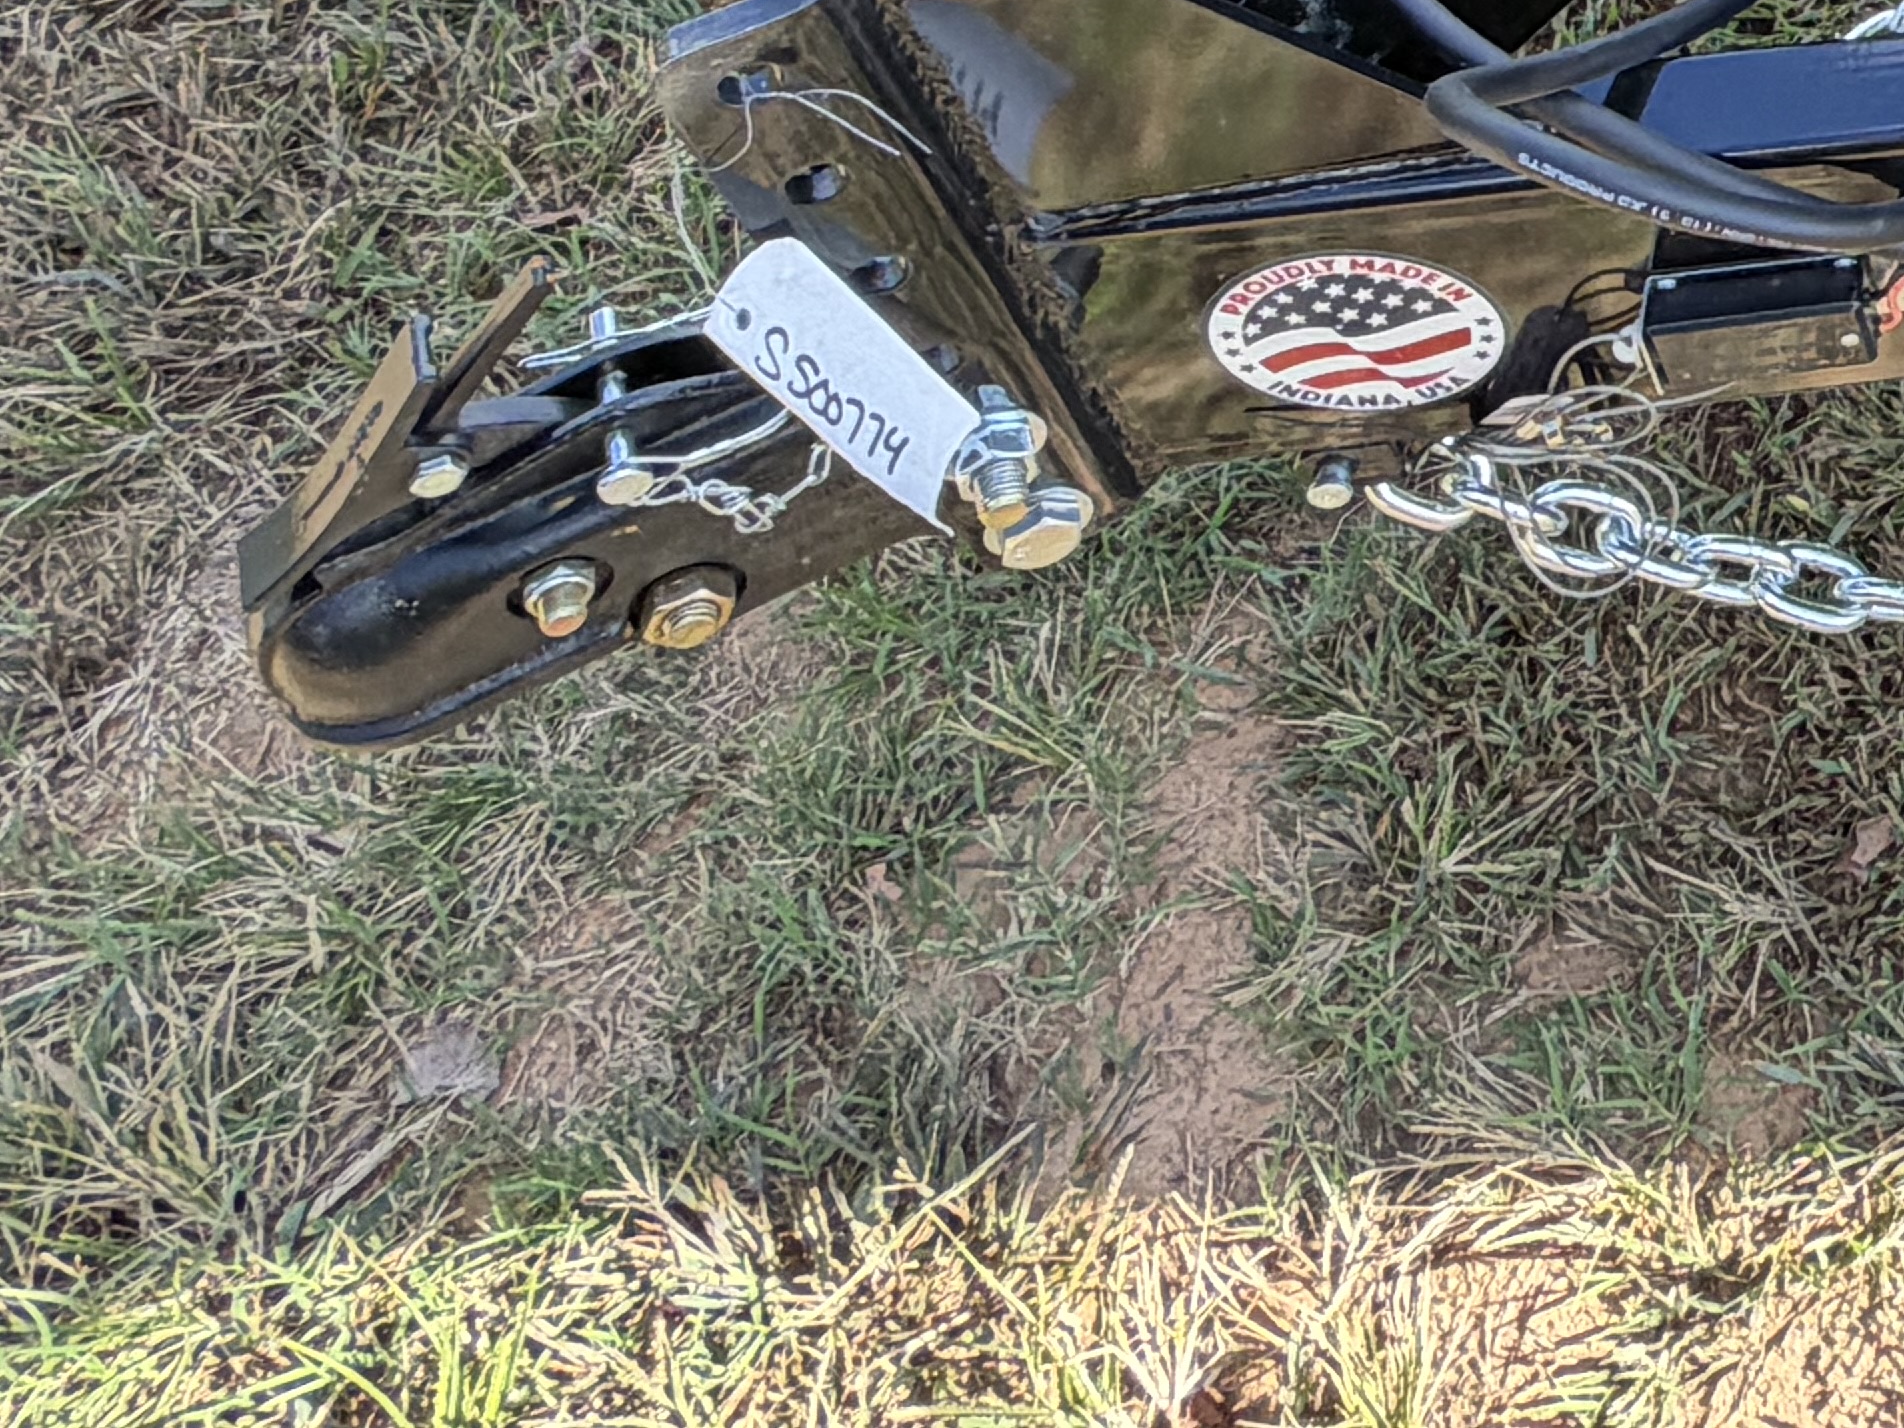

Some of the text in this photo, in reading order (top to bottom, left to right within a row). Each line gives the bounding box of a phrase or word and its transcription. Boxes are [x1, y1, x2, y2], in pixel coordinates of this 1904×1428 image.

[1219, 258, 1474, 317] PROUDLY MADE IN
[1414, 375, 1472, 401] USA
